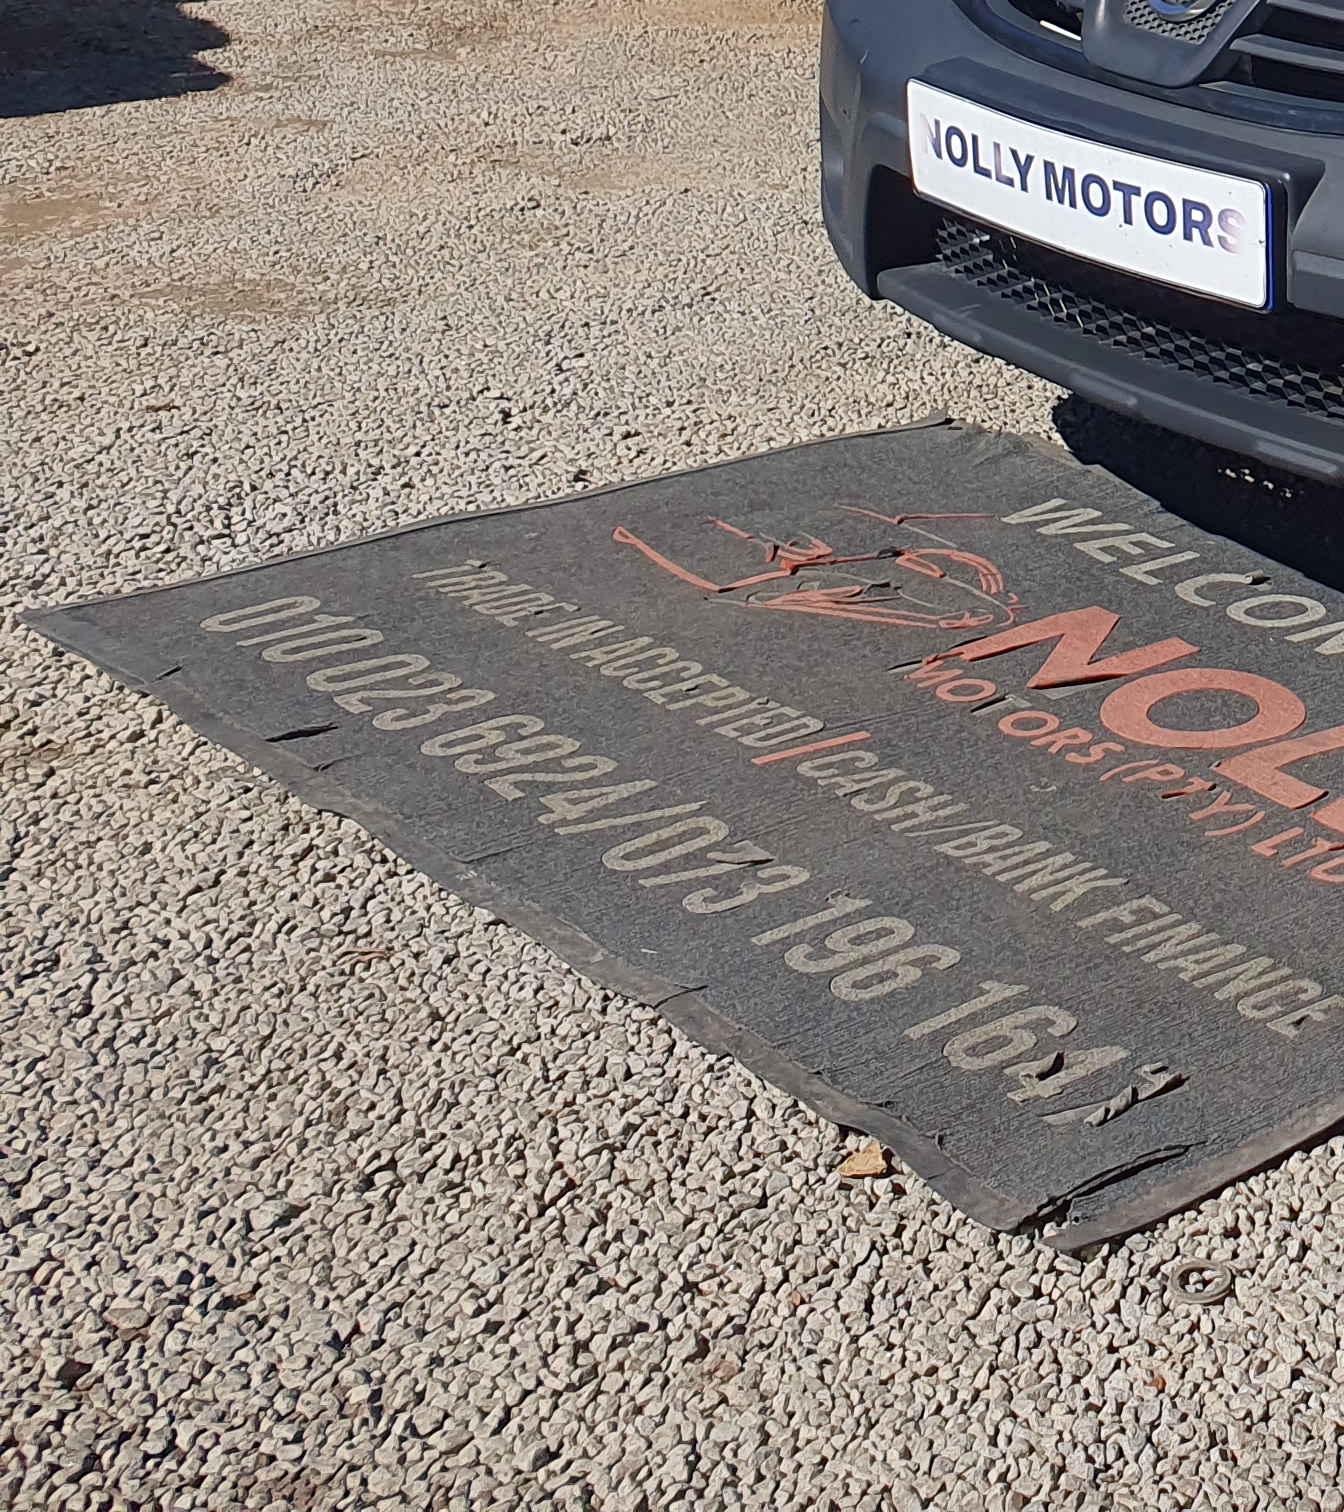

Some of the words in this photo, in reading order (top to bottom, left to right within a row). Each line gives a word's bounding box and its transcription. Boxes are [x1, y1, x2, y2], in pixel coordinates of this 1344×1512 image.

[919, 113, 1036, 194] NOLLY
[1043, 159, 1247, 255] MOTORS
[411, 559, 581, 627] TRADE
[526, 615, 625, 650] IN
[200, 595, 384, 663] 010
[306, 653, 498, 732] 023
[750, 890, 961, 1002] 196
[904, 660, 1126, 764] MOTORS
[1100, 759, 1267, 837] (PTY)
